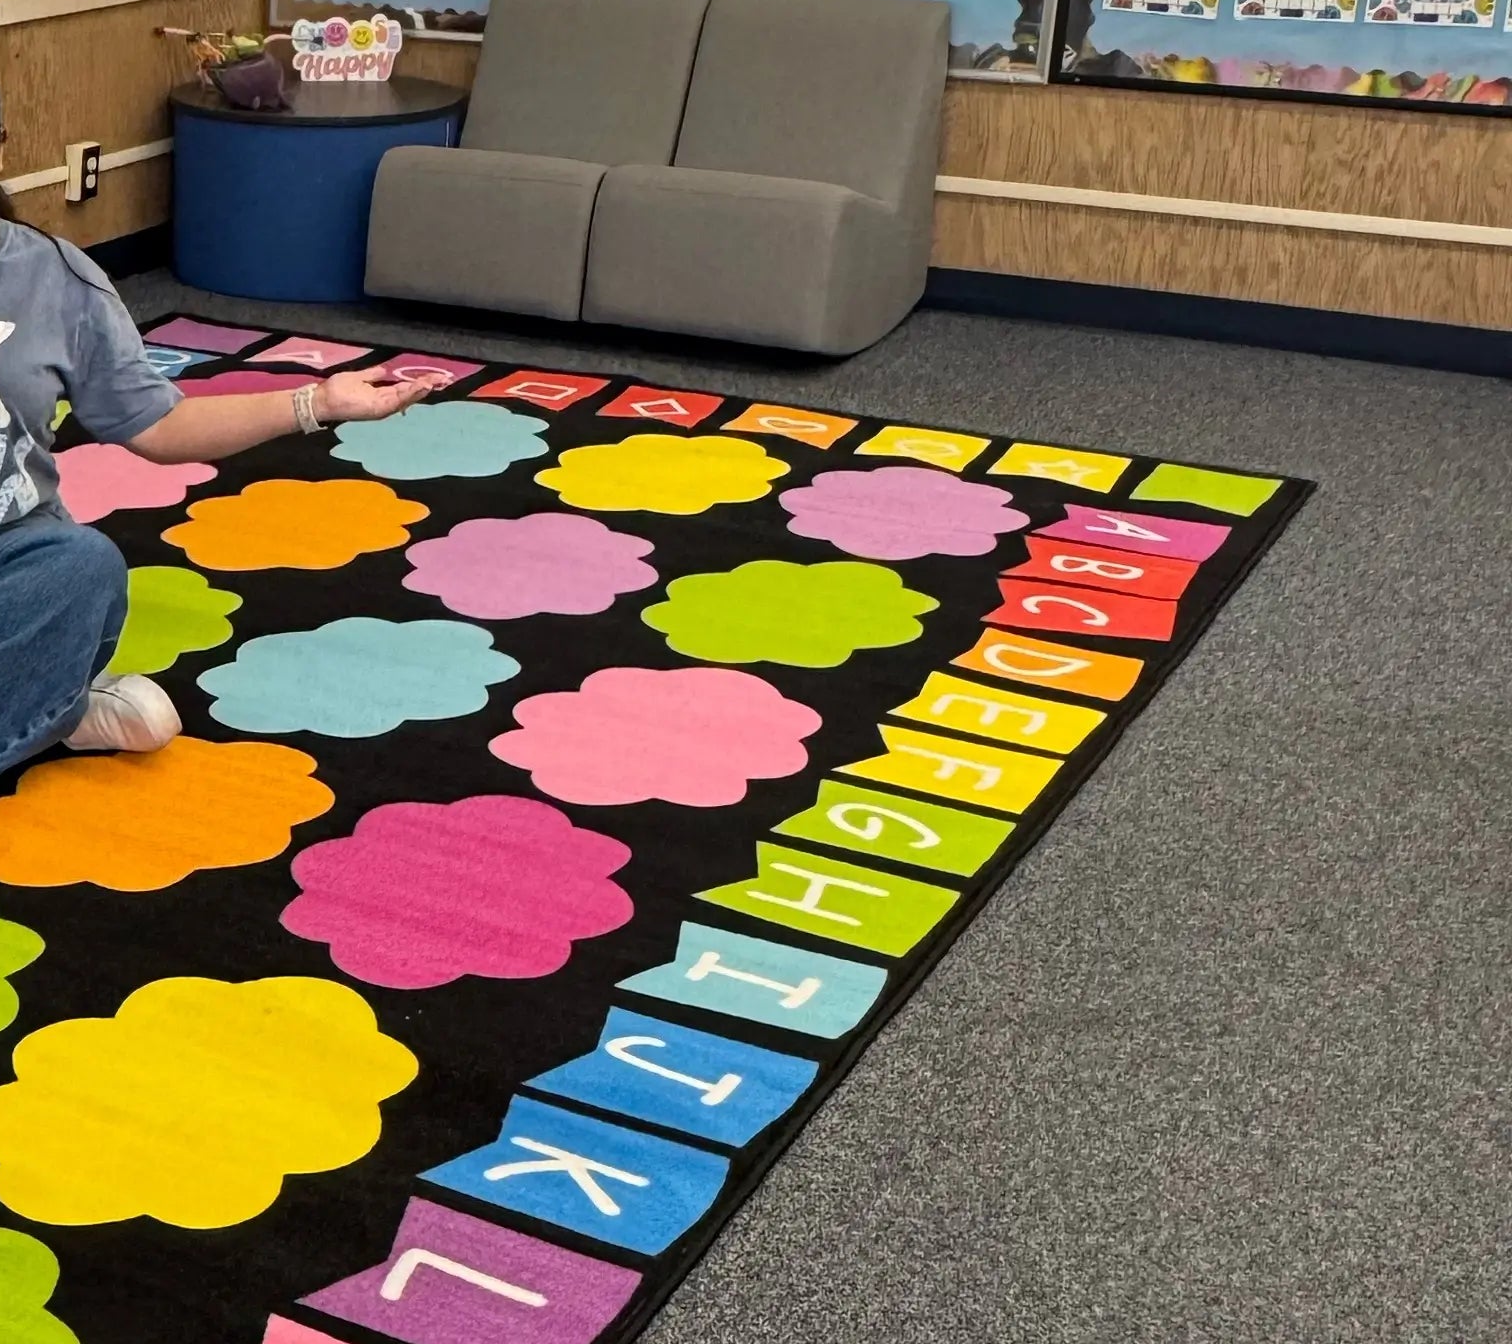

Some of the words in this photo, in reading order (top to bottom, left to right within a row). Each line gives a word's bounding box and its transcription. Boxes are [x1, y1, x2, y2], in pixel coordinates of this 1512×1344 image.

[296, 52, 397, 80] Happy
[1085, 513, 1170, 543] A
[1050, 555, 1146, 582] B
[1020, 594, 1110, 627] C
[982, 642, 1093, 677] D
[930, 691, 1047, 737] E
[895, 743, 1002, 792] F
[825, 801, 941, 849] G
[746, 861, 890, 927] H
[683, 950, 822, 1010] I
[604, 1035, 742, 1106] J
[483, 1136, 651, 1218] K
[379, 1247, 550, 1303] L
